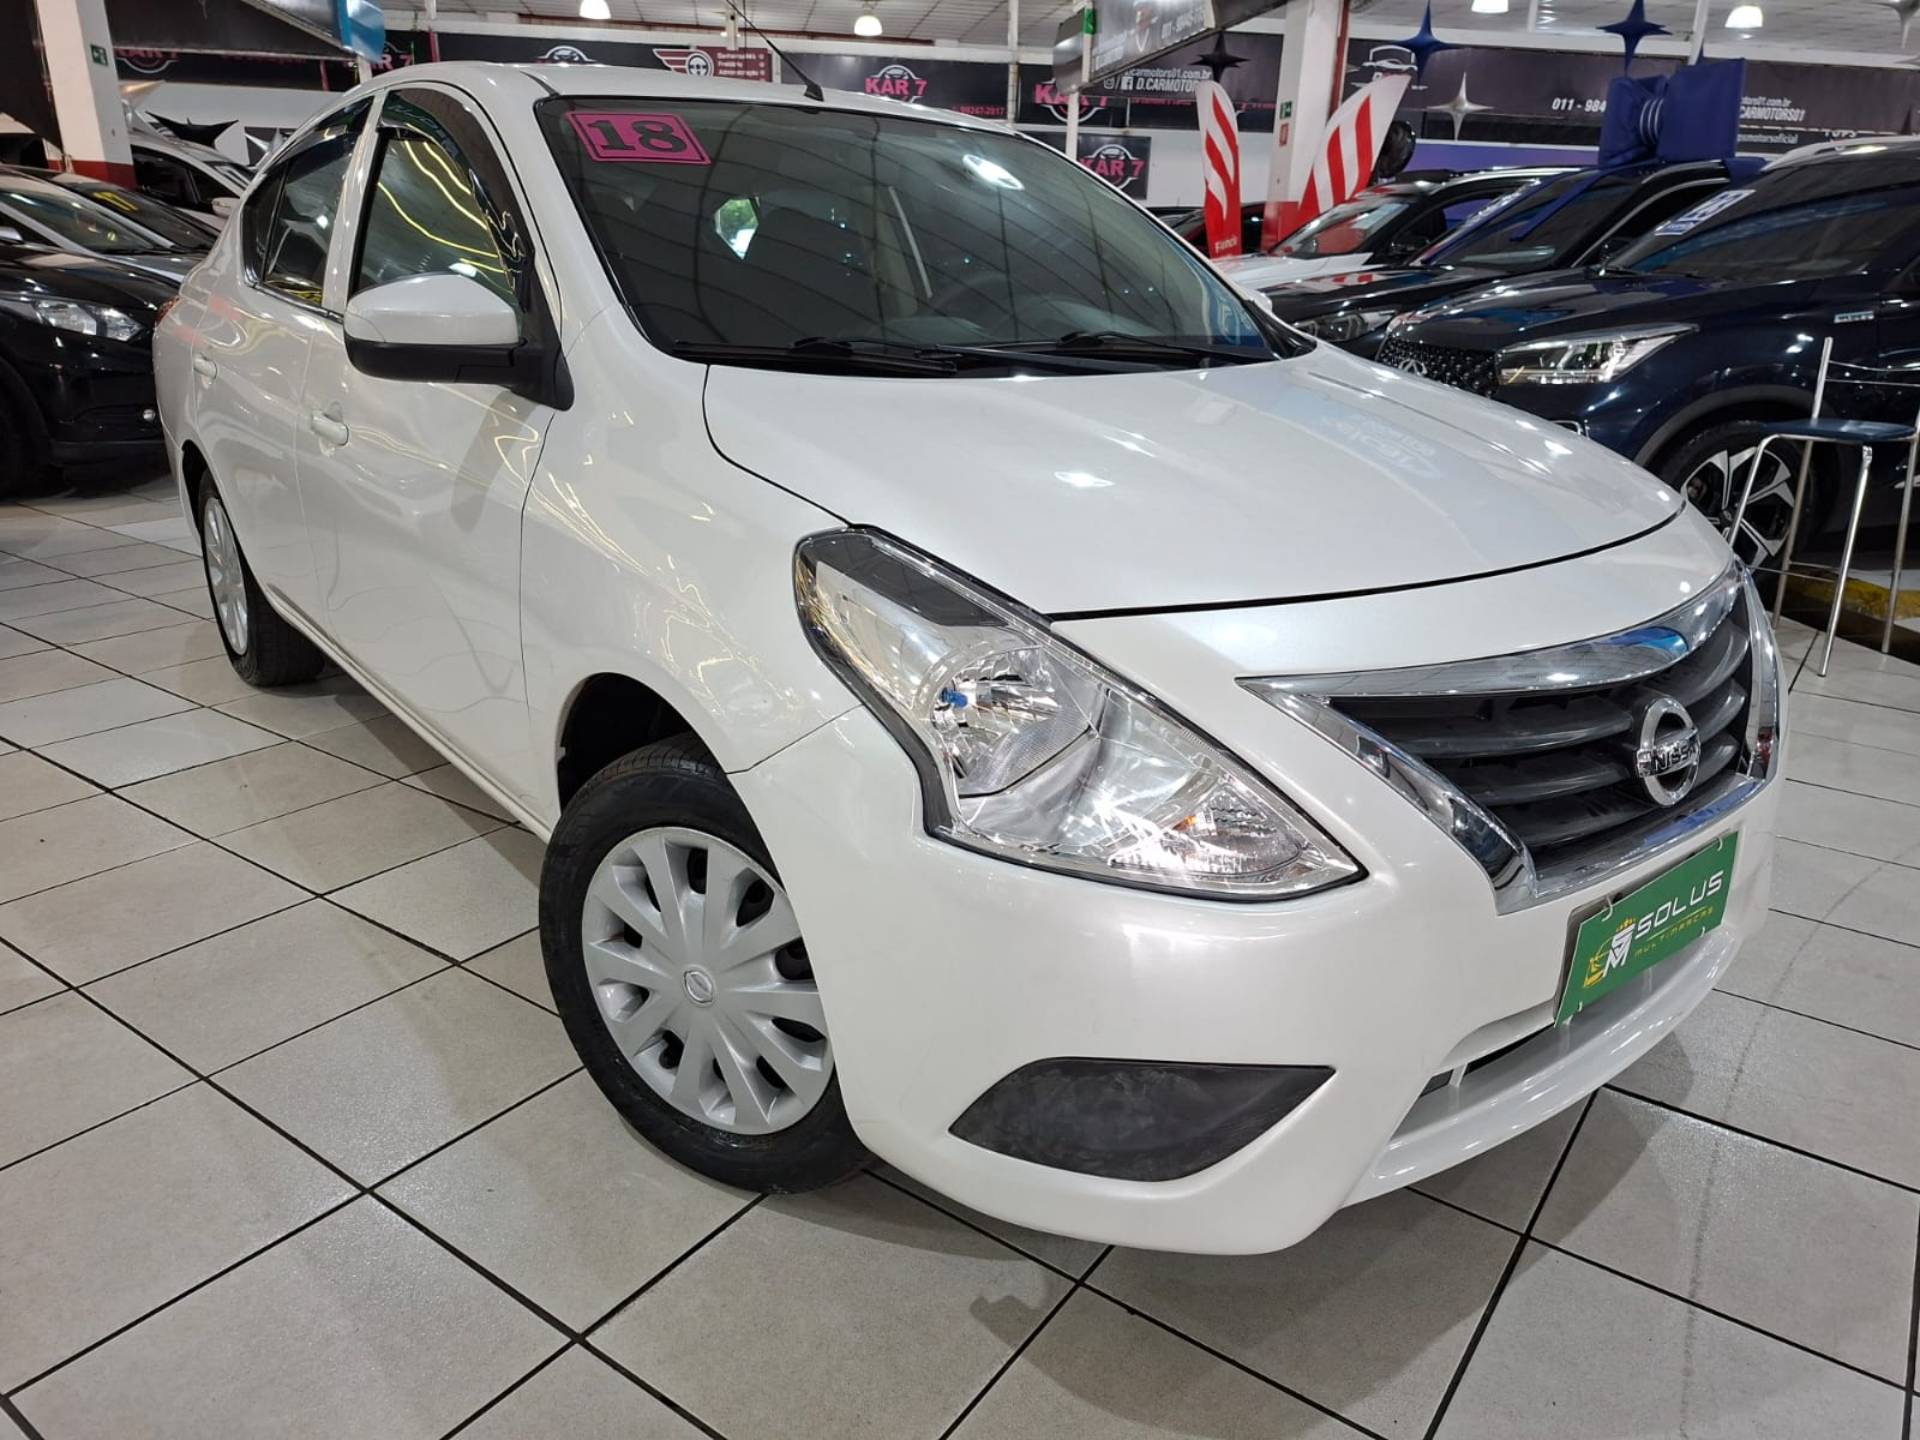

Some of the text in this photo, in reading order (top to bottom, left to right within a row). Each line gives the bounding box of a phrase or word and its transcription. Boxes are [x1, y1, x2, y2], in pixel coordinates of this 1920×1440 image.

[864, 78, 928, 95] KAR 7
[1552, 97, 1575, 111] 011
[587, 120, 687, 153] 18
[1131, 160, 1146, 177] 7
[1651, 741, 1697, 772] NISSA
[1634, 870, 1724, 940] SOLUS
